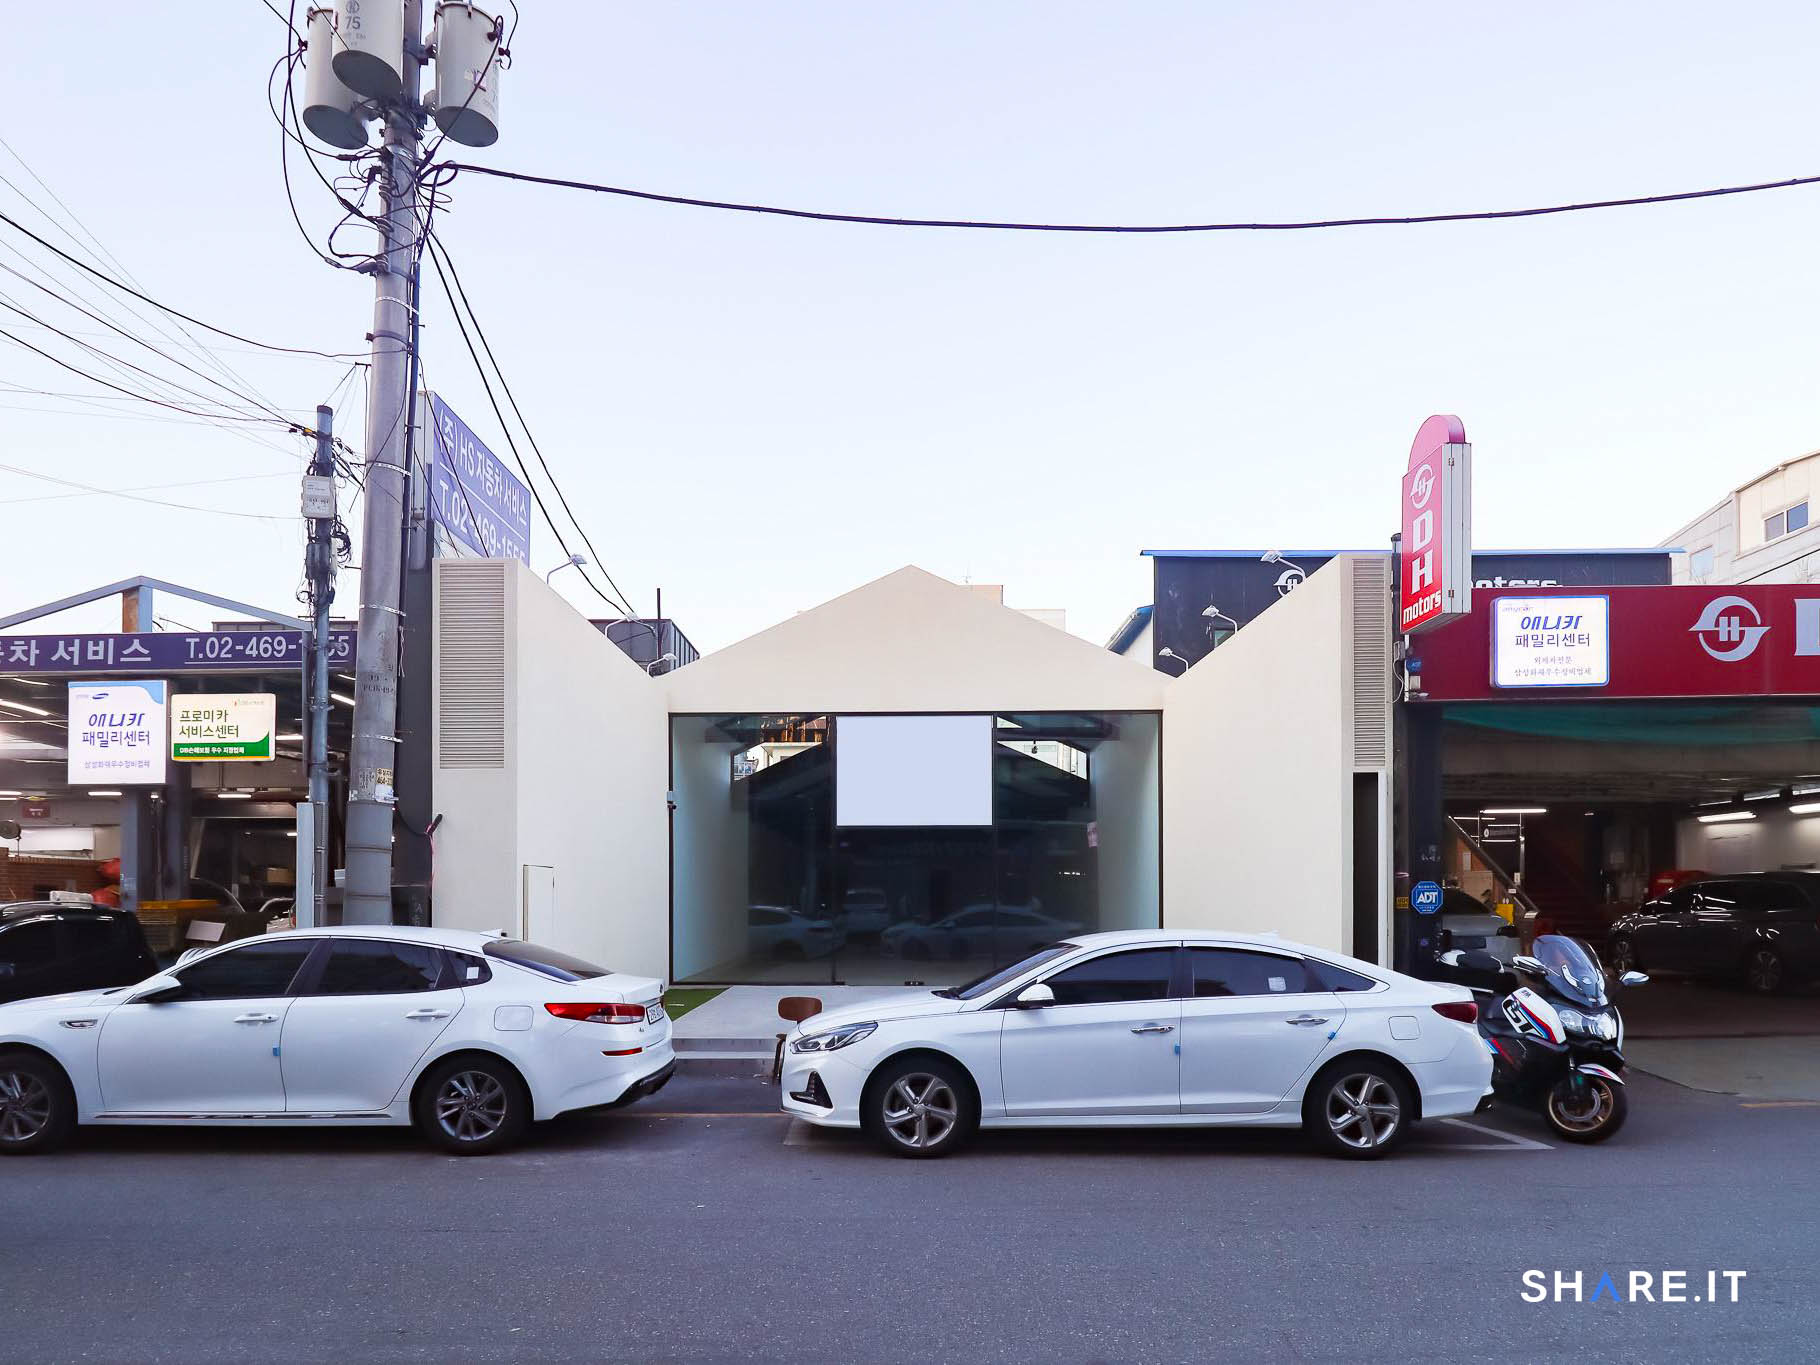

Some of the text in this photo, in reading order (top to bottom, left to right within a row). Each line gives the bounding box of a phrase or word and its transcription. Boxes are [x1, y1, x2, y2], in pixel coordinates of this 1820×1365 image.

[345, 16, 361, 30] 75
[476, 450, 503, 506] 자동차
[504, 475, 527, 527] 서비스
[1403, 590, 1441, 625] motors
[1515, 633, 1590, 648] 패밀리센터
[50, 637, 152, 666] 서비스
[179, 709, 229, 723] 프로미카
[82, 731, 150, 748] 패밀리센터
[179, 725, 239, 739] 서비스센터
[1416, 891, 1438, 904] ADT
